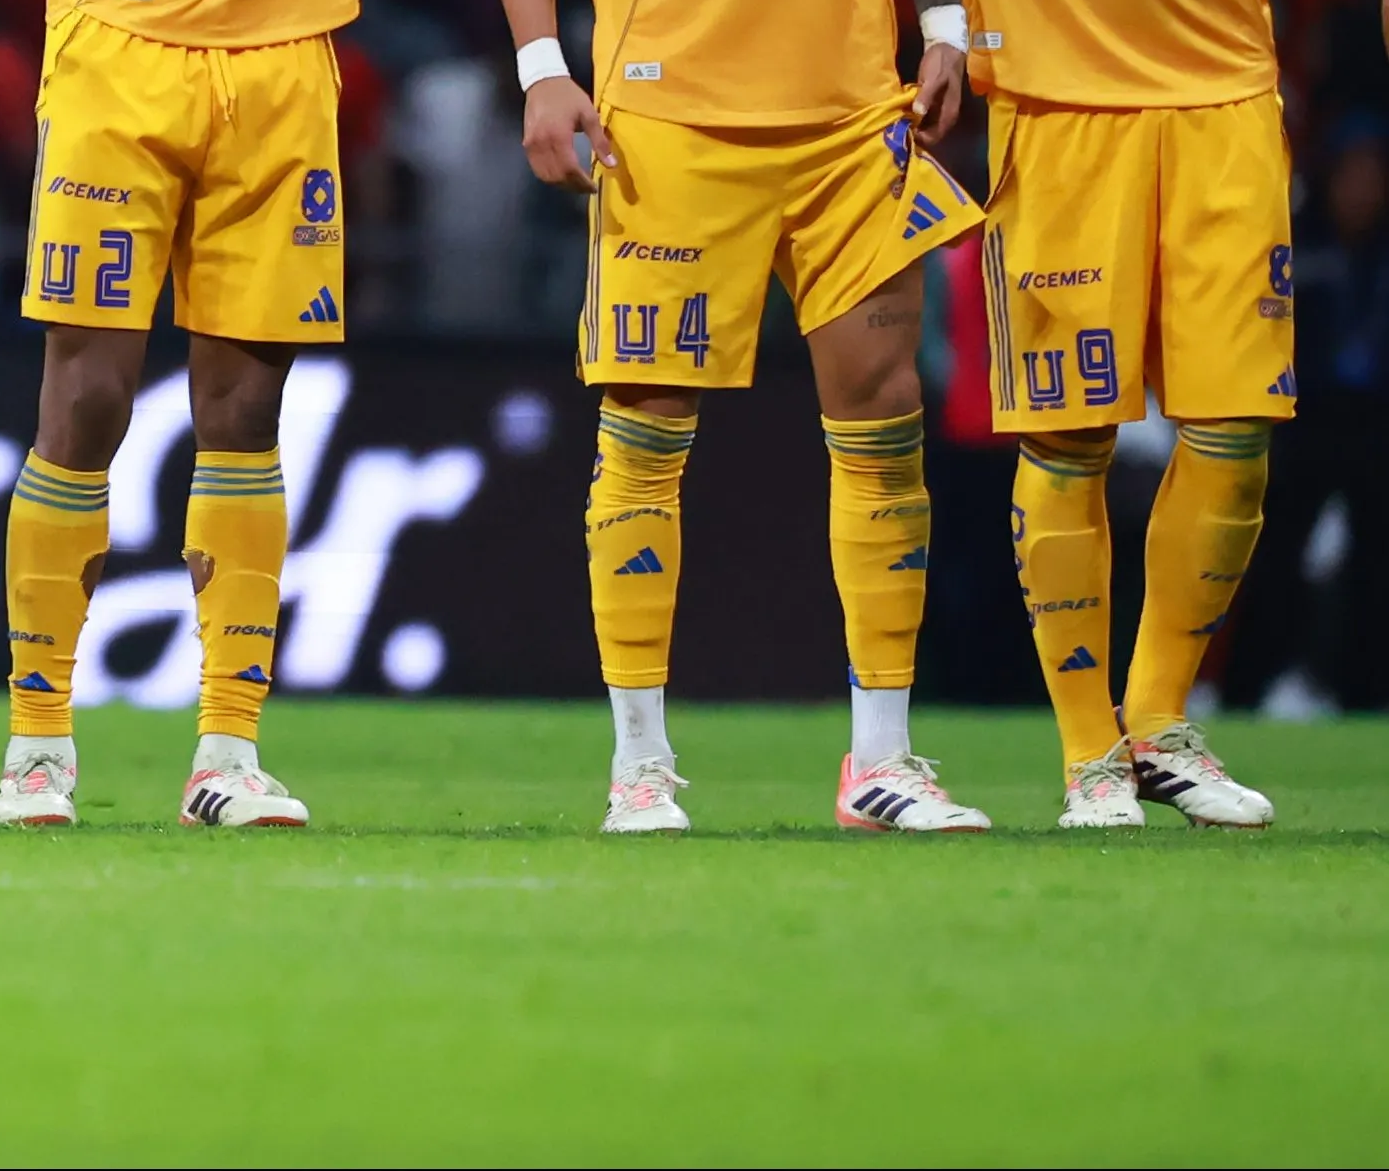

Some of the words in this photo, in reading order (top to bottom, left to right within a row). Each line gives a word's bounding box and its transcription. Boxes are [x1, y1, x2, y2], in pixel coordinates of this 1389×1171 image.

[63, 182, 132, 205] CEMEX
[95, 230, 133, 308] 2
[636, 245, 702, 263] CEMEX
[1033, 268, 1102, 288] CEMEX
[675, 292, 710, 368] 4
[1076, 329, 1119, 406] 9
